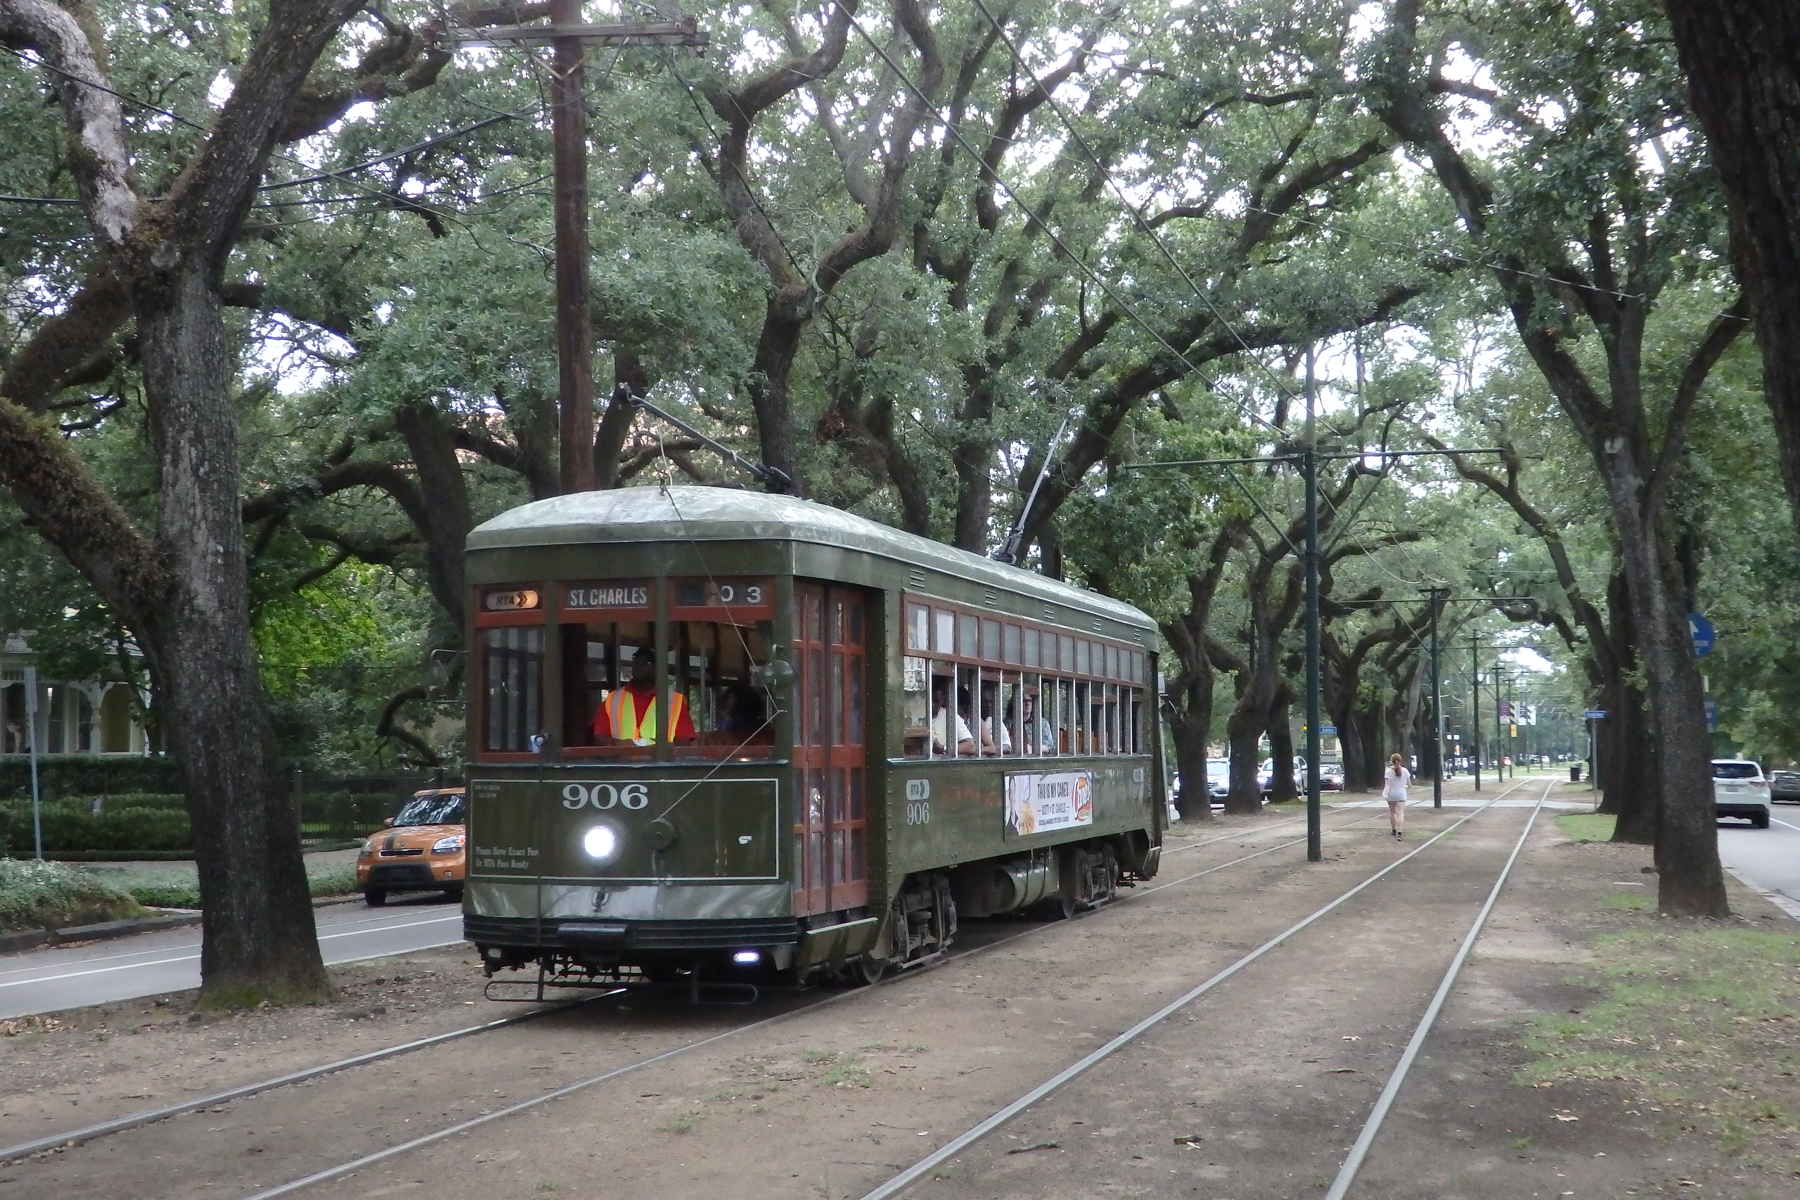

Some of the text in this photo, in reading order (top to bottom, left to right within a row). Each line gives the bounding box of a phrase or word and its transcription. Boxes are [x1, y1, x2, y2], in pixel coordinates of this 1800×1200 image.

[570, 586, 647, 606] ST. CHARLES
[562, 783, 649, 810] 906
[907, 802, 930, 826] 906
